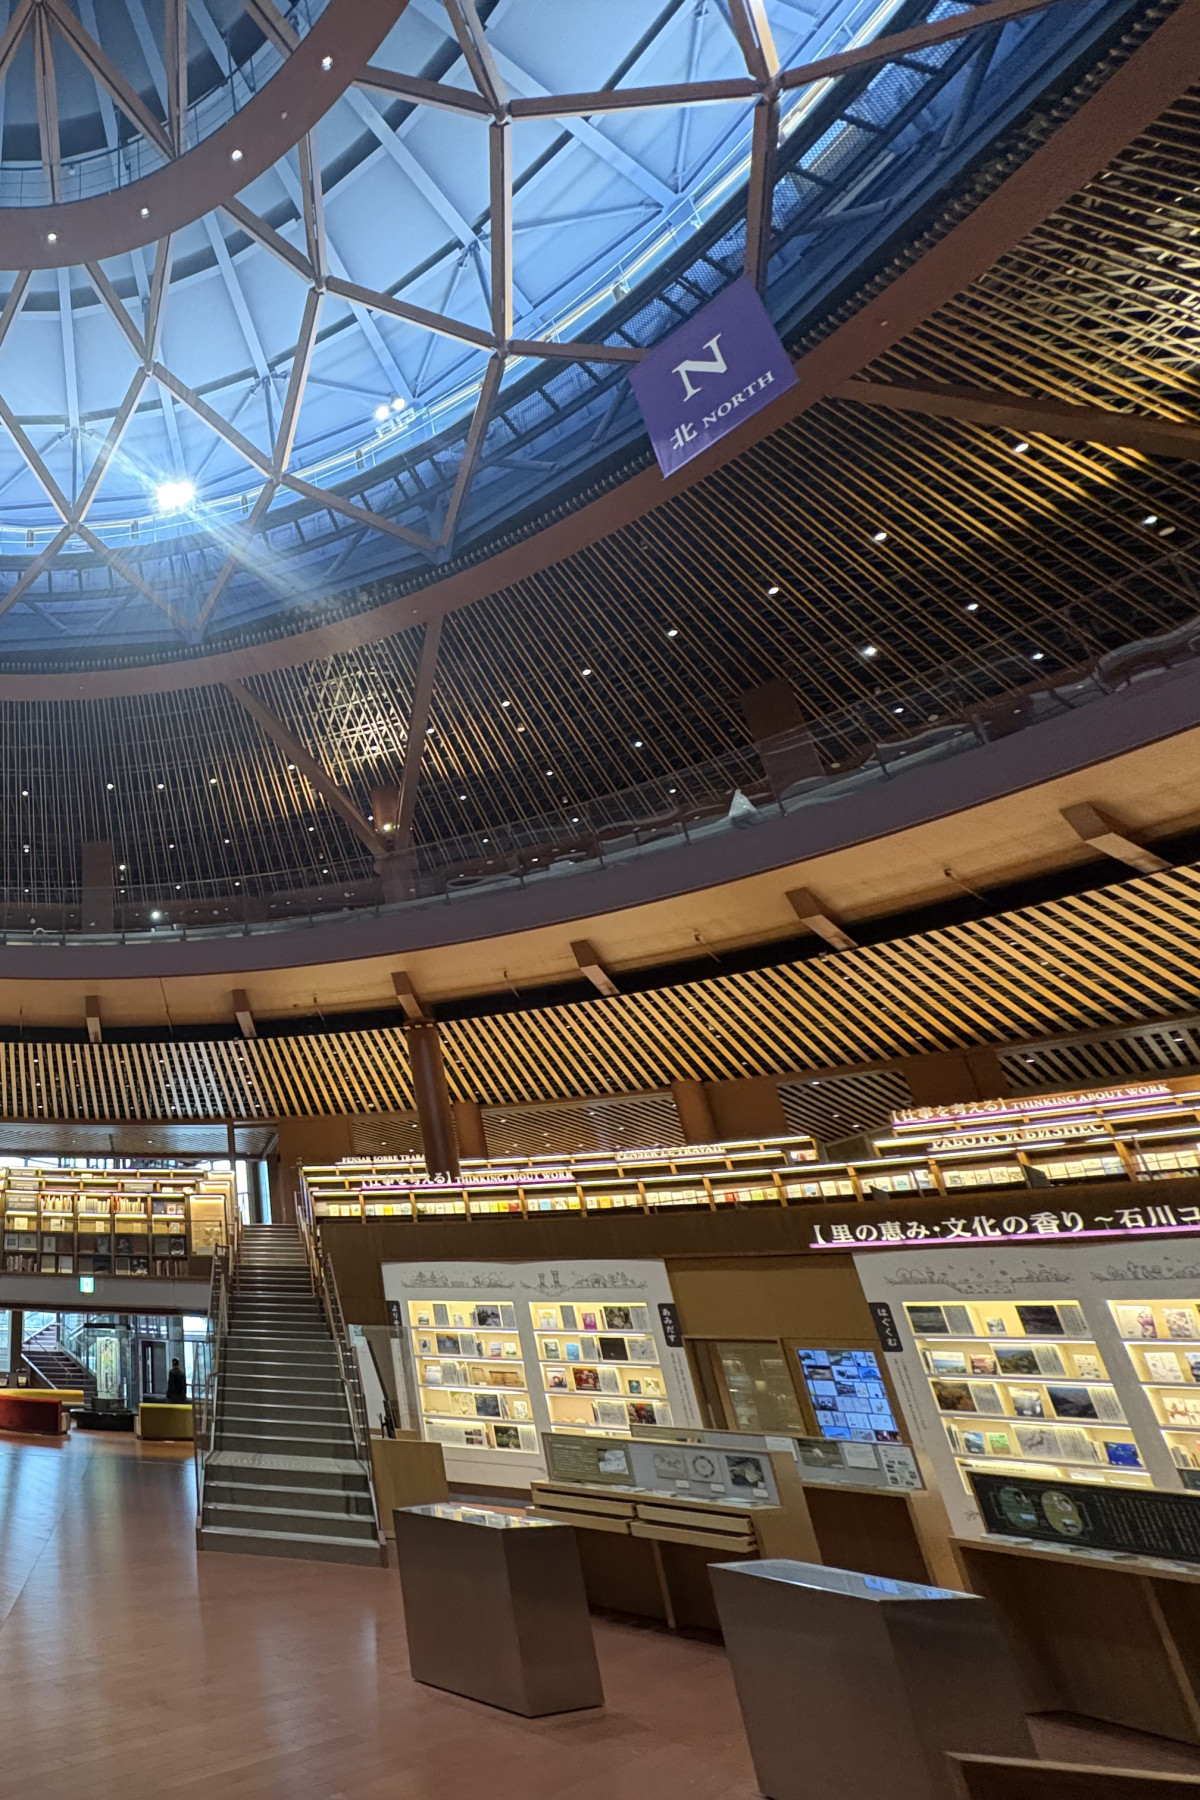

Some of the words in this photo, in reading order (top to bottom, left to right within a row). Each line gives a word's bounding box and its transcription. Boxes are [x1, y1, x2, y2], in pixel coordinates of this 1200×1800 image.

[672, 333, 728, 402] N
[670, 422, 698, 449] 北
[702, 370, 776, 429] NORTH
[1011, 1094, 1077, 1111] THINKING
[1079, 1088, 1123, 1103] ABOUT
[1125, 1083, 1171, 1097] WORK
[455, 1174, 505, 1185] THINKING
[506, 1172, 540, 1182] ABOUT
[542, 1169, 575, 1181] WORK
[877, 1308, 898, 1347] はぐくむ
